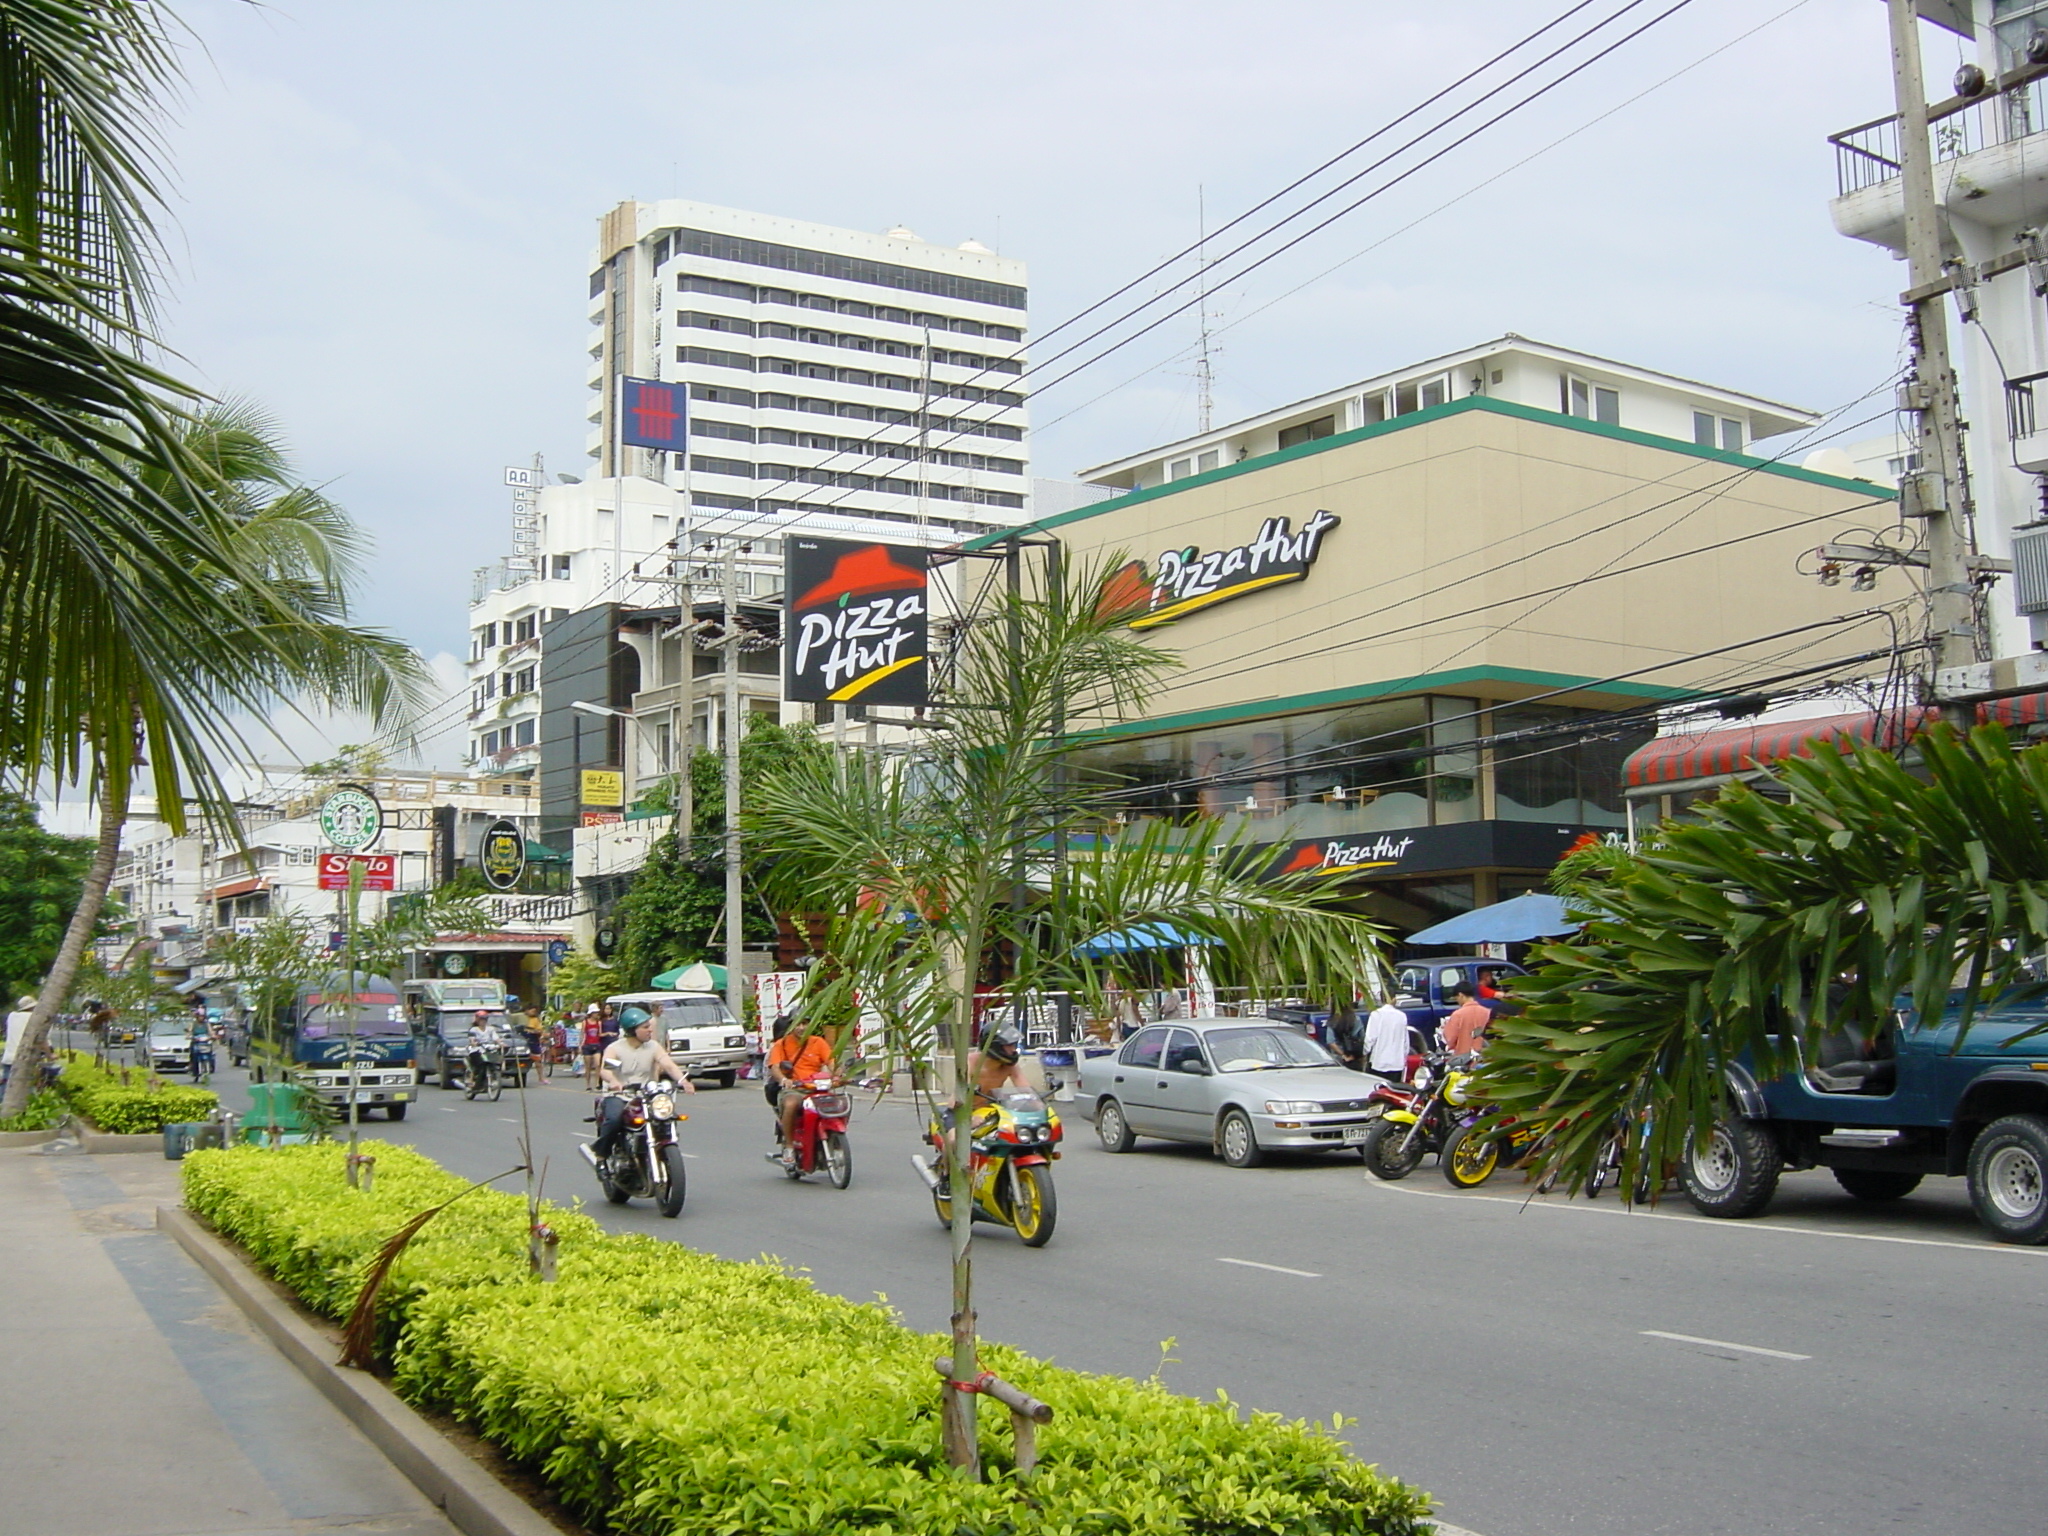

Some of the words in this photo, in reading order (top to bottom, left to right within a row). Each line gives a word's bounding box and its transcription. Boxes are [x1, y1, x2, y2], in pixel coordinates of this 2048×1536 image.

[516, 490, 525, 553] HOTEL
[1150, 547, 1245, 611] Pizza
[1249, 511, 1333, 575] Hut
[795, 592, 925, 676] Pizza
[819, 627, 915, 690] Hut
[325, 793, 376, 818] STARBUCKS
[330, 829, 371, 845] COFFEE
[1322, 841, 1371, 868] Pizza
[1372, 835, 1414, 860] Hut
[325, 855, 388, 873] Stlo
